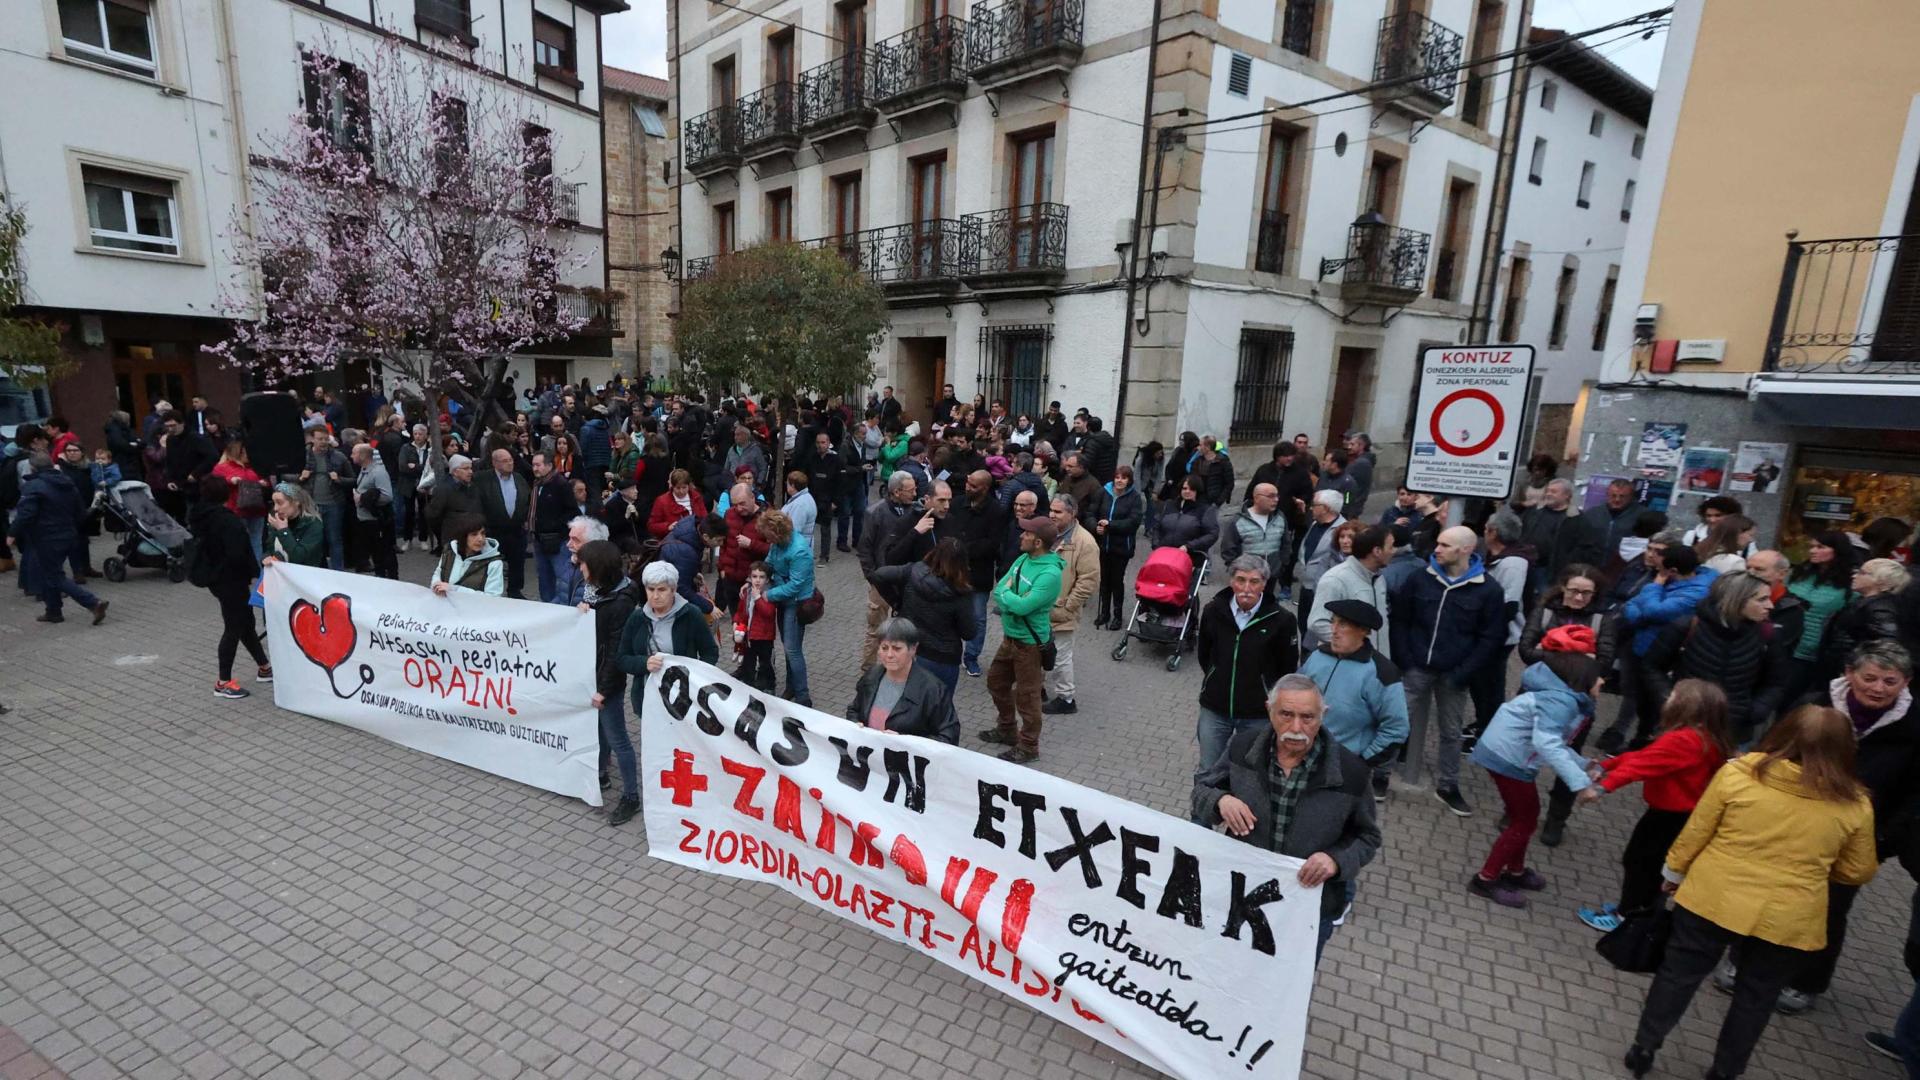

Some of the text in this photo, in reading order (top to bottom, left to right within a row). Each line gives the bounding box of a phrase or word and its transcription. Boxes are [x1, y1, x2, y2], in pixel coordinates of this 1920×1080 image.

[1442, 352, 1512, 363] KONTUZ
[369, 630, 452, 664] Altsasun
[433, 628, 447, 638] en
[502, 629, 529, 653] YA!
[403, 657, 517, 715] ORAIN!
[360, 689, 389, 708] OSASUN
[425, 708, 442, 722] ETA
[442, 712, 506, 736] KALITATEZKOA
[510, 723, 569, 752] GUZTIENTZAT
[658, 665, 1284, 957] OSASUN ETXEAK
